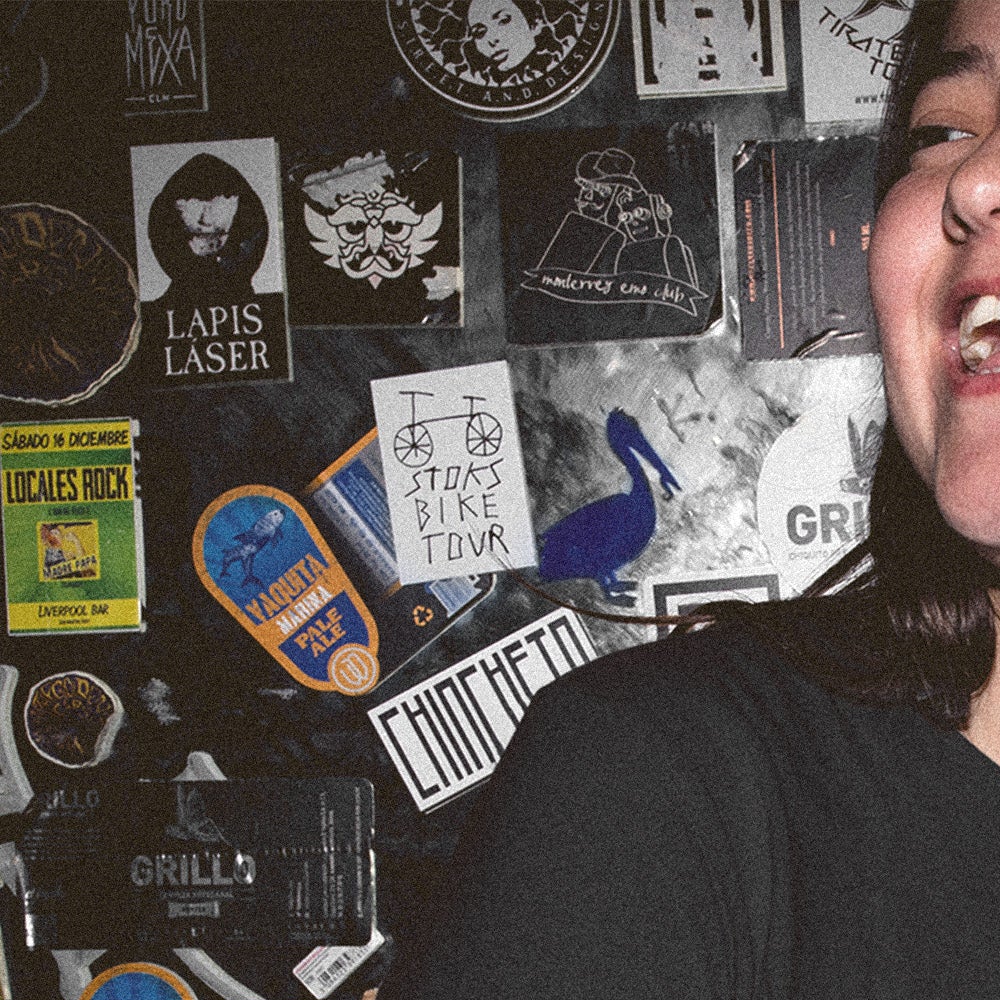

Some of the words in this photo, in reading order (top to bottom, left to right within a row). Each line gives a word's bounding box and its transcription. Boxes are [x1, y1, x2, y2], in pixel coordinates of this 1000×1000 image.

[167, 303, 263, 340] LAPIS
[164, 337, 271, 376] LÁSER
[2, 430, 50, 450] SÁBADO
[53, 432, 65, 446] 16
[69, 430, 129, 446] DICIEMBRE
[5, 470, 80, 504] LOCALES
[83, 467, 129, 501] ROCK
[405, 458, 504, 498] STOKS
[415, 493, 499, 532] BIKE
[38, 604, 87, 618] LIVERPOOL
[91, 603, 109, 615] BAR
[276, 585, 332, 635] MARINA
[294, 607, 343, 650] PALE
[311, 623, 346, 658] ALE
[130, 854, 257, 888] GRILLO
